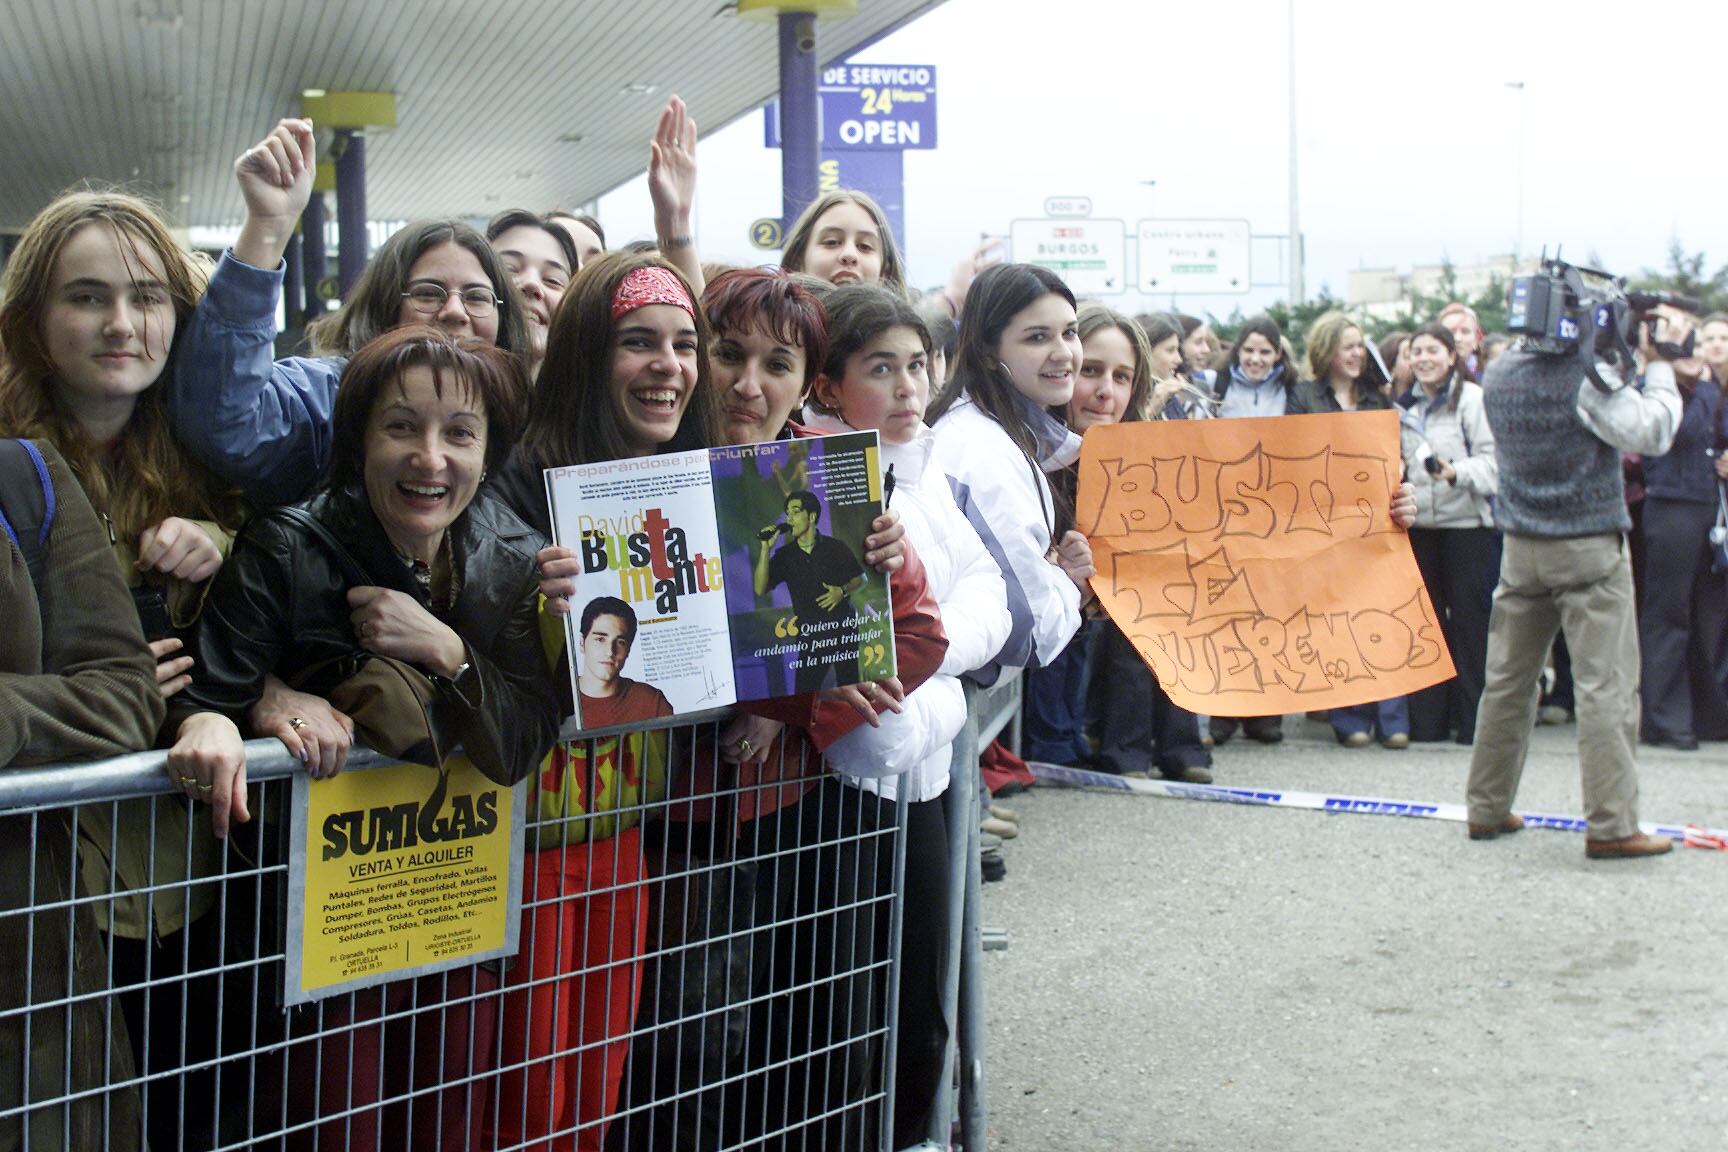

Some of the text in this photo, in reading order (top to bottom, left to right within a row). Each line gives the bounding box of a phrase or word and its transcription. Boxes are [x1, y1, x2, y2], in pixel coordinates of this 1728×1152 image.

[823, 66, 930, 86] DE SERVICIO
[860, 87, 893, 115] 24
[839, 119, 920, 145] OPEN
[758, 225, 772, 245] 2
[1037, 243, 1100, 255] BURGOS
[553, 456, 681, 480] Preparándose
[709, 444, 780, 461] triunfar
[1087, 440, 1405, 542] BUSTA
[578, 508, 645, 540] David
[1111, 538, 1264, 627] TE
[800, 610, 882, 637] Quiero dejar el
[754, 628, 884, 658] andamio para triunfar
[789, 649, 860, 670] en la música
[322, 772, 498, 862] SUMIGAS
[349, 845, 474, 878] VENTA Y ALQUILER
[464, 865, 488, 876] Vallas
[368, 893, 393, 904] Redes
[396, 889, 407, 898] de
[460, 875, 497, 887] Martillos
[407, 896, 440, 907] Grupos
[456, 895, 498, 909] Andamios
